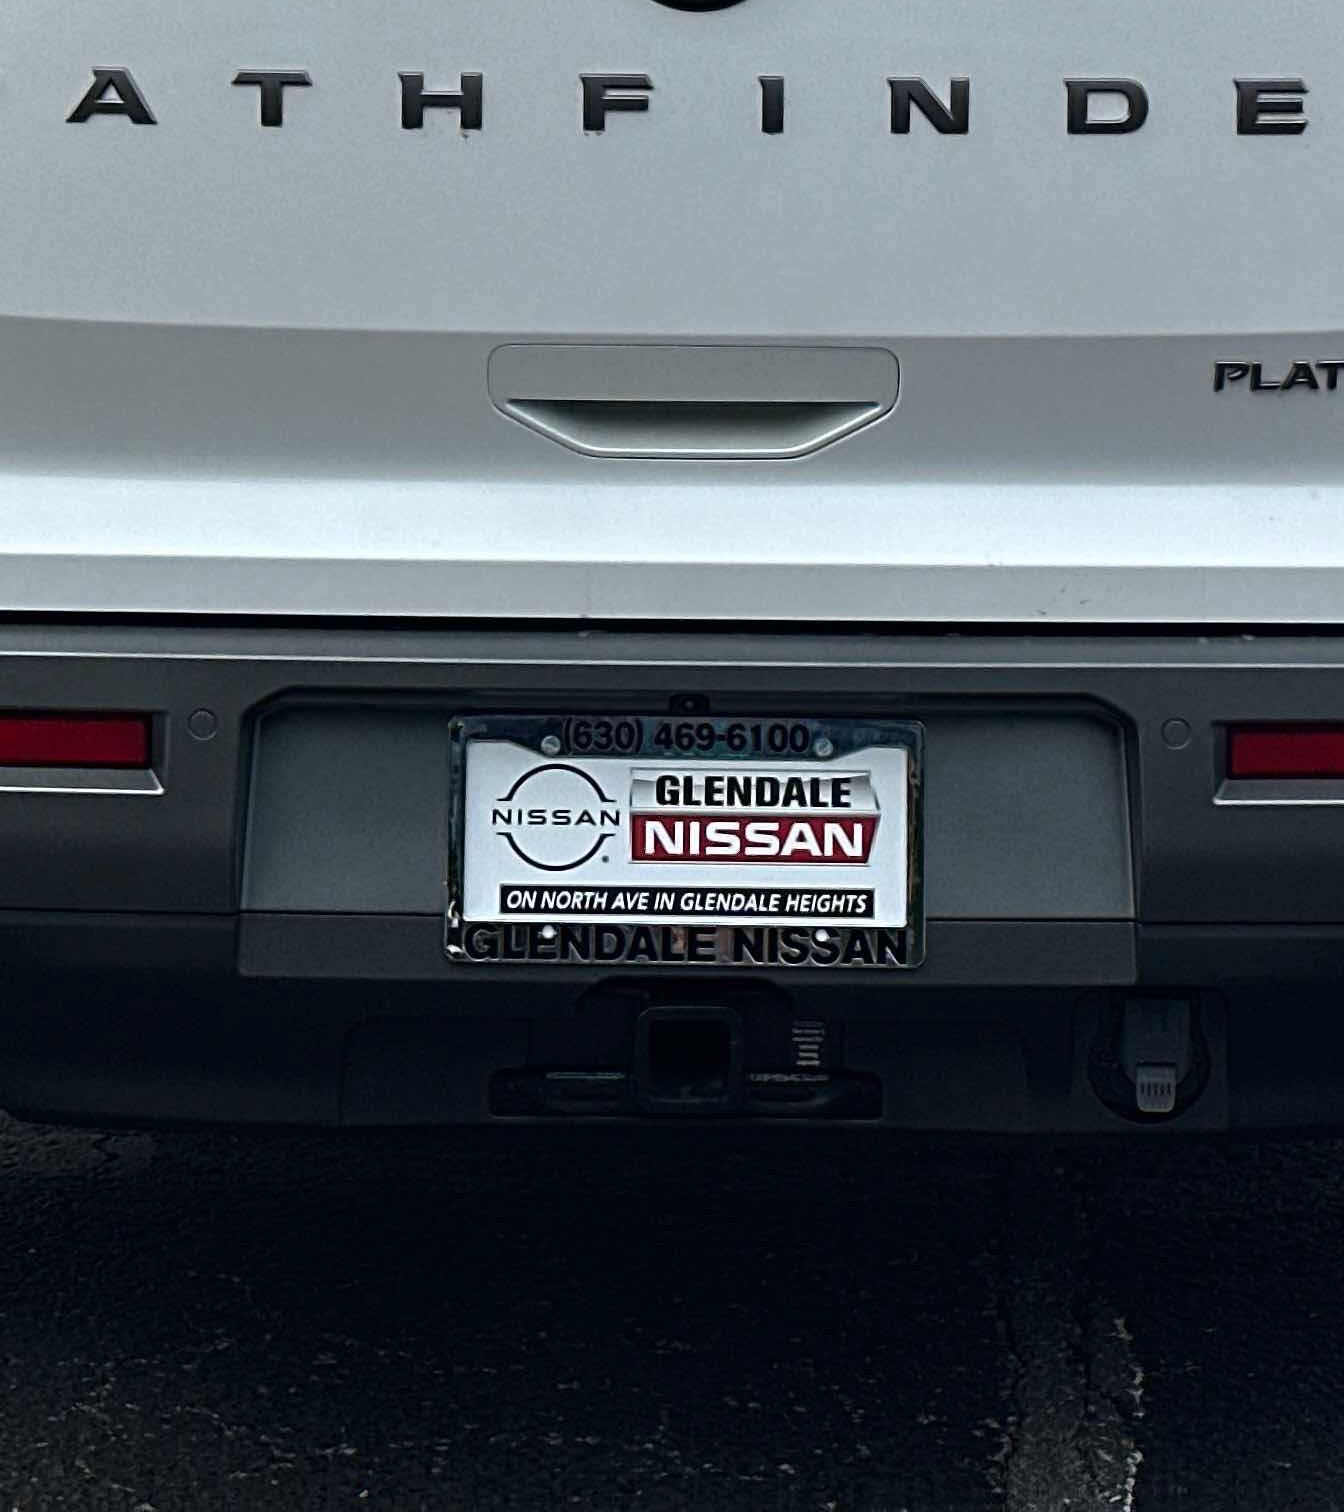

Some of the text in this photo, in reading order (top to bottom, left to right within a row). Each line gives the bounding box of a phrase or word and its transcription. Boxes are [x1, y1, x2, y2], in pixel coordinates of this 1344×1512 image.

[564, 720, 811, 755] (630) 469-6100
[656, 774, 853, 809] GLENDALE
[492, 808, 621, 827] NISSAN
[644, 819, 865, 857] NISSAN
[506, 890, 869, 914] ON NORTH AVE IN GLENDALE HEIGHTS
[464, 921, 907, 966] GLENDALE NISSAN
